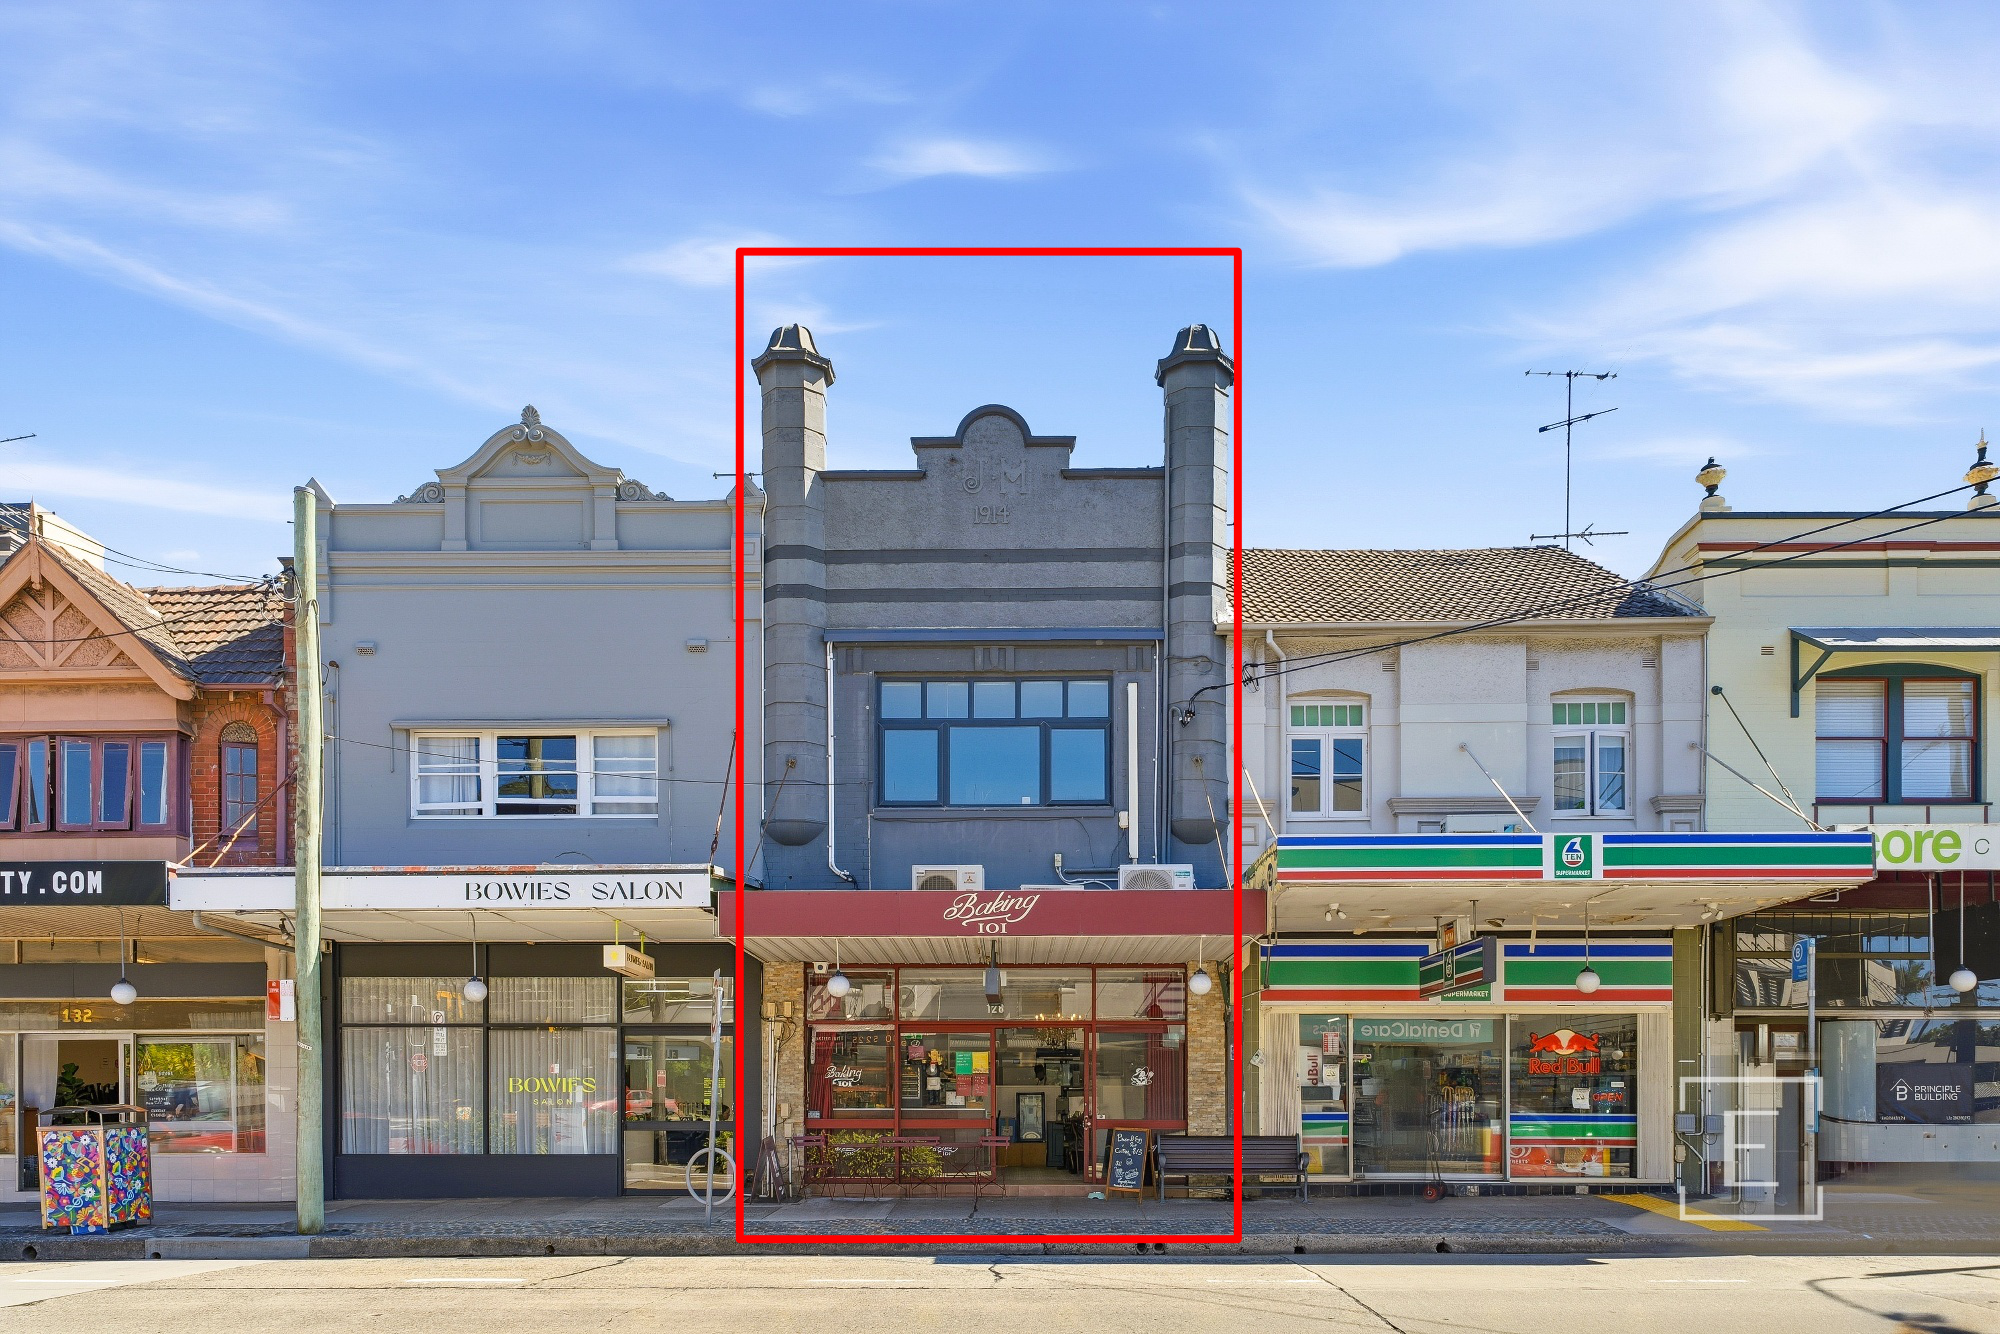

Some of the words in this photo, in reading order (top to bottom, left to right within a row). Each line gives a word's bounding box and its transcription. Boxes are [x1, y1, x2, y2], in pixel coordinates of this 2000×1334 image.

[973, 504, 1011, 525] 1914
[1876, 829, 1962, 864] ore
[1564, 853, 1582, 861] TEN
[0, 870, 102, 894] TY.COM
[465, 881, 571, 900] BOWIES
[591, 881, 683, 900] SALON
[943, 891, 1041, 927] Baking
[62, 1008, 92, 1023] 132
[1528, 1057, 1564, 1075] Red
[1566, 1057, 1601, 1075] Bull
[825, 1065, 862, 1086] Baking
[508, 1077, 597, 1094] BOWIES
[1914, 1085, 1962, 1093] PRINCIPLE
[532, 1098, 573, 1106] SALON
[1592, 1092, 1624, 1103] OPEN
[1914, 1093, 1958, 1101] BUILDING
